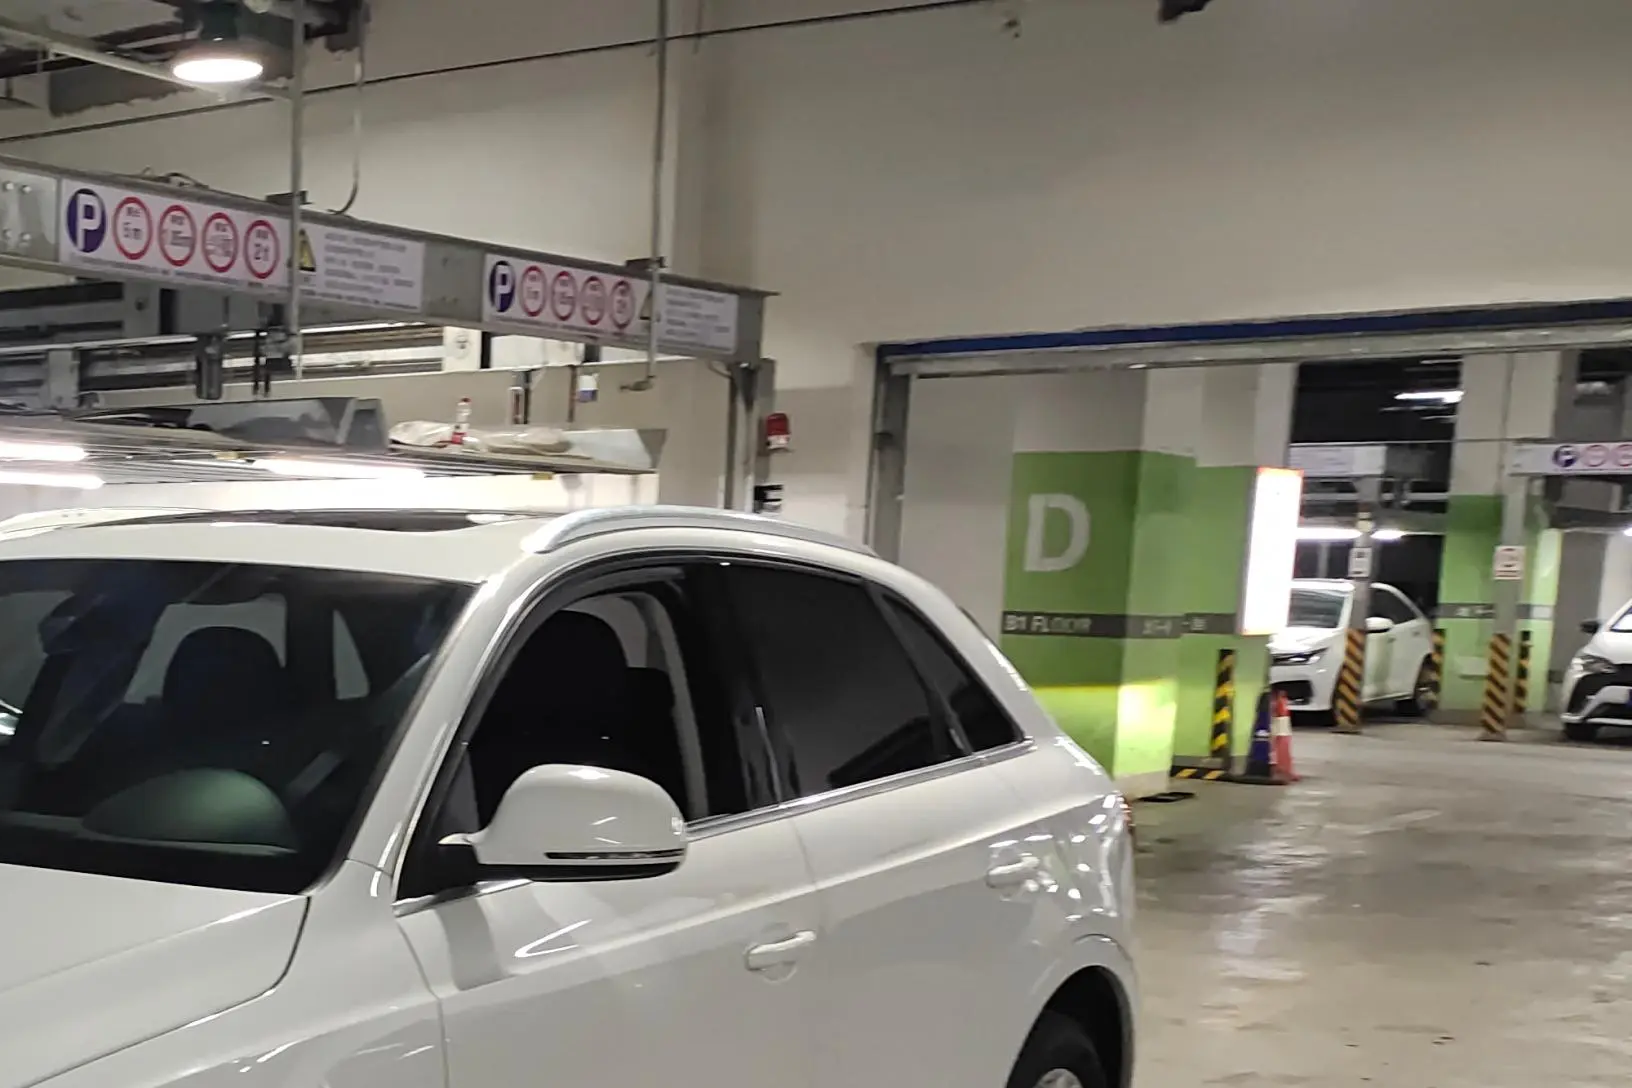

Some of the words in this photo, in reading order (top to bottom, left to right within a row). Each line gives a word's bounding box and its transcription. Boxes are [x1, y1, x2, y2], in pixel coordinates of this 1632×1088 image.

[75, 193, 102, 251] P
[494, 266, 513, 312] P
[1023, 493, 1091, 573] D
